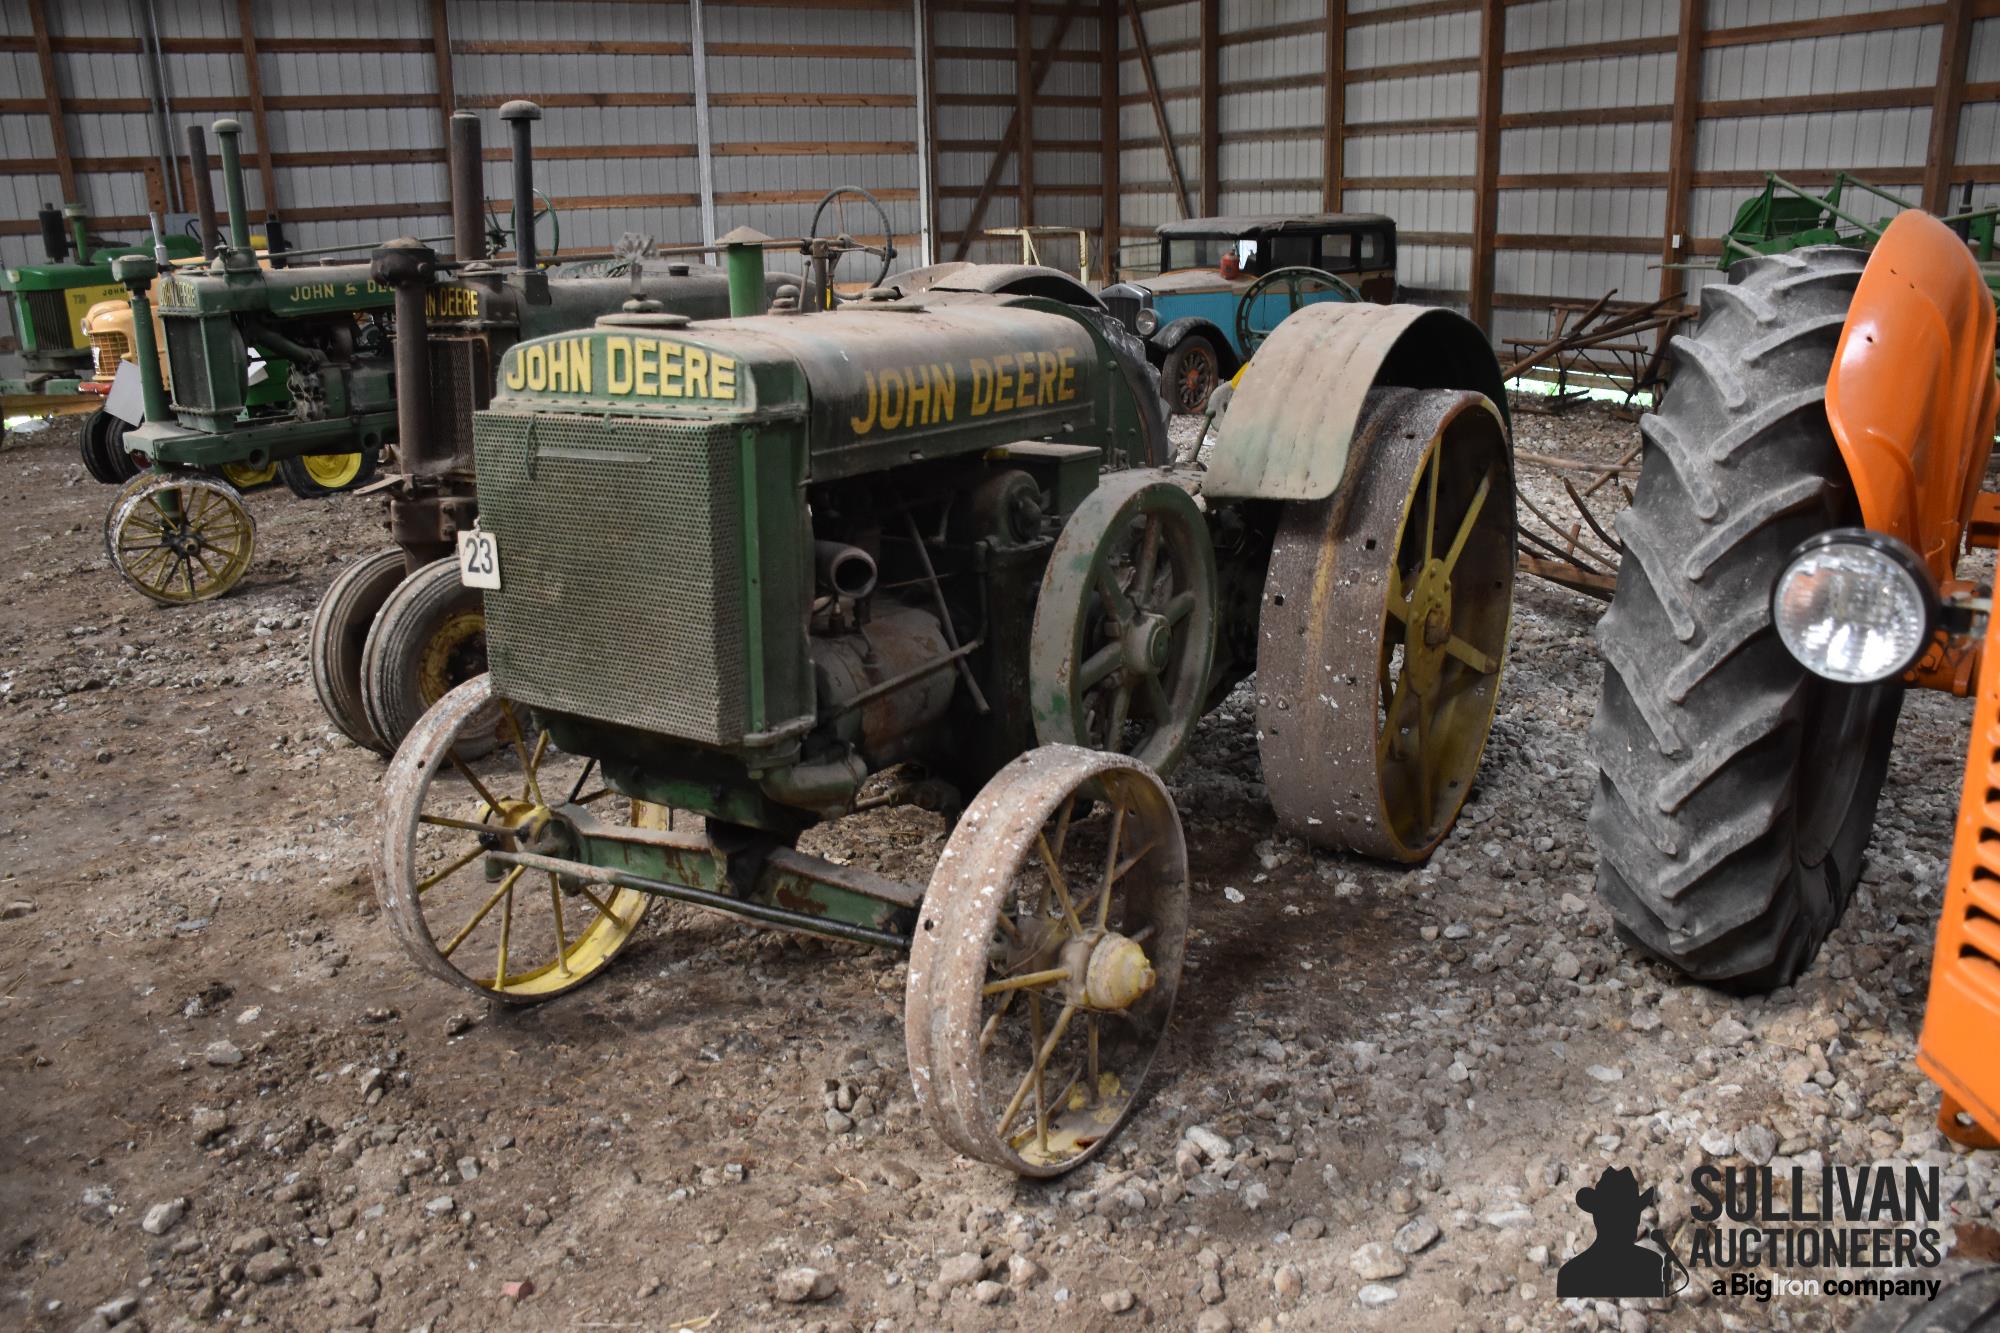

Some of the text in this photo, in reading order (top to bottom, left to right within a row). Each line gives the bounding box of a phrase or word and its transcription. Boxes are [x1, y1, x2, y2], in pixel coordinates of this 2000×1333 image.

[290, 283, 335, 302] JOHN
[440, 287, 479, 316] DEERE
[506, 336, 737, 400] JOHN DEERE
[851, 347, 1077, 435] JOHN DEERE
[465, 537, 493, 575] 23
